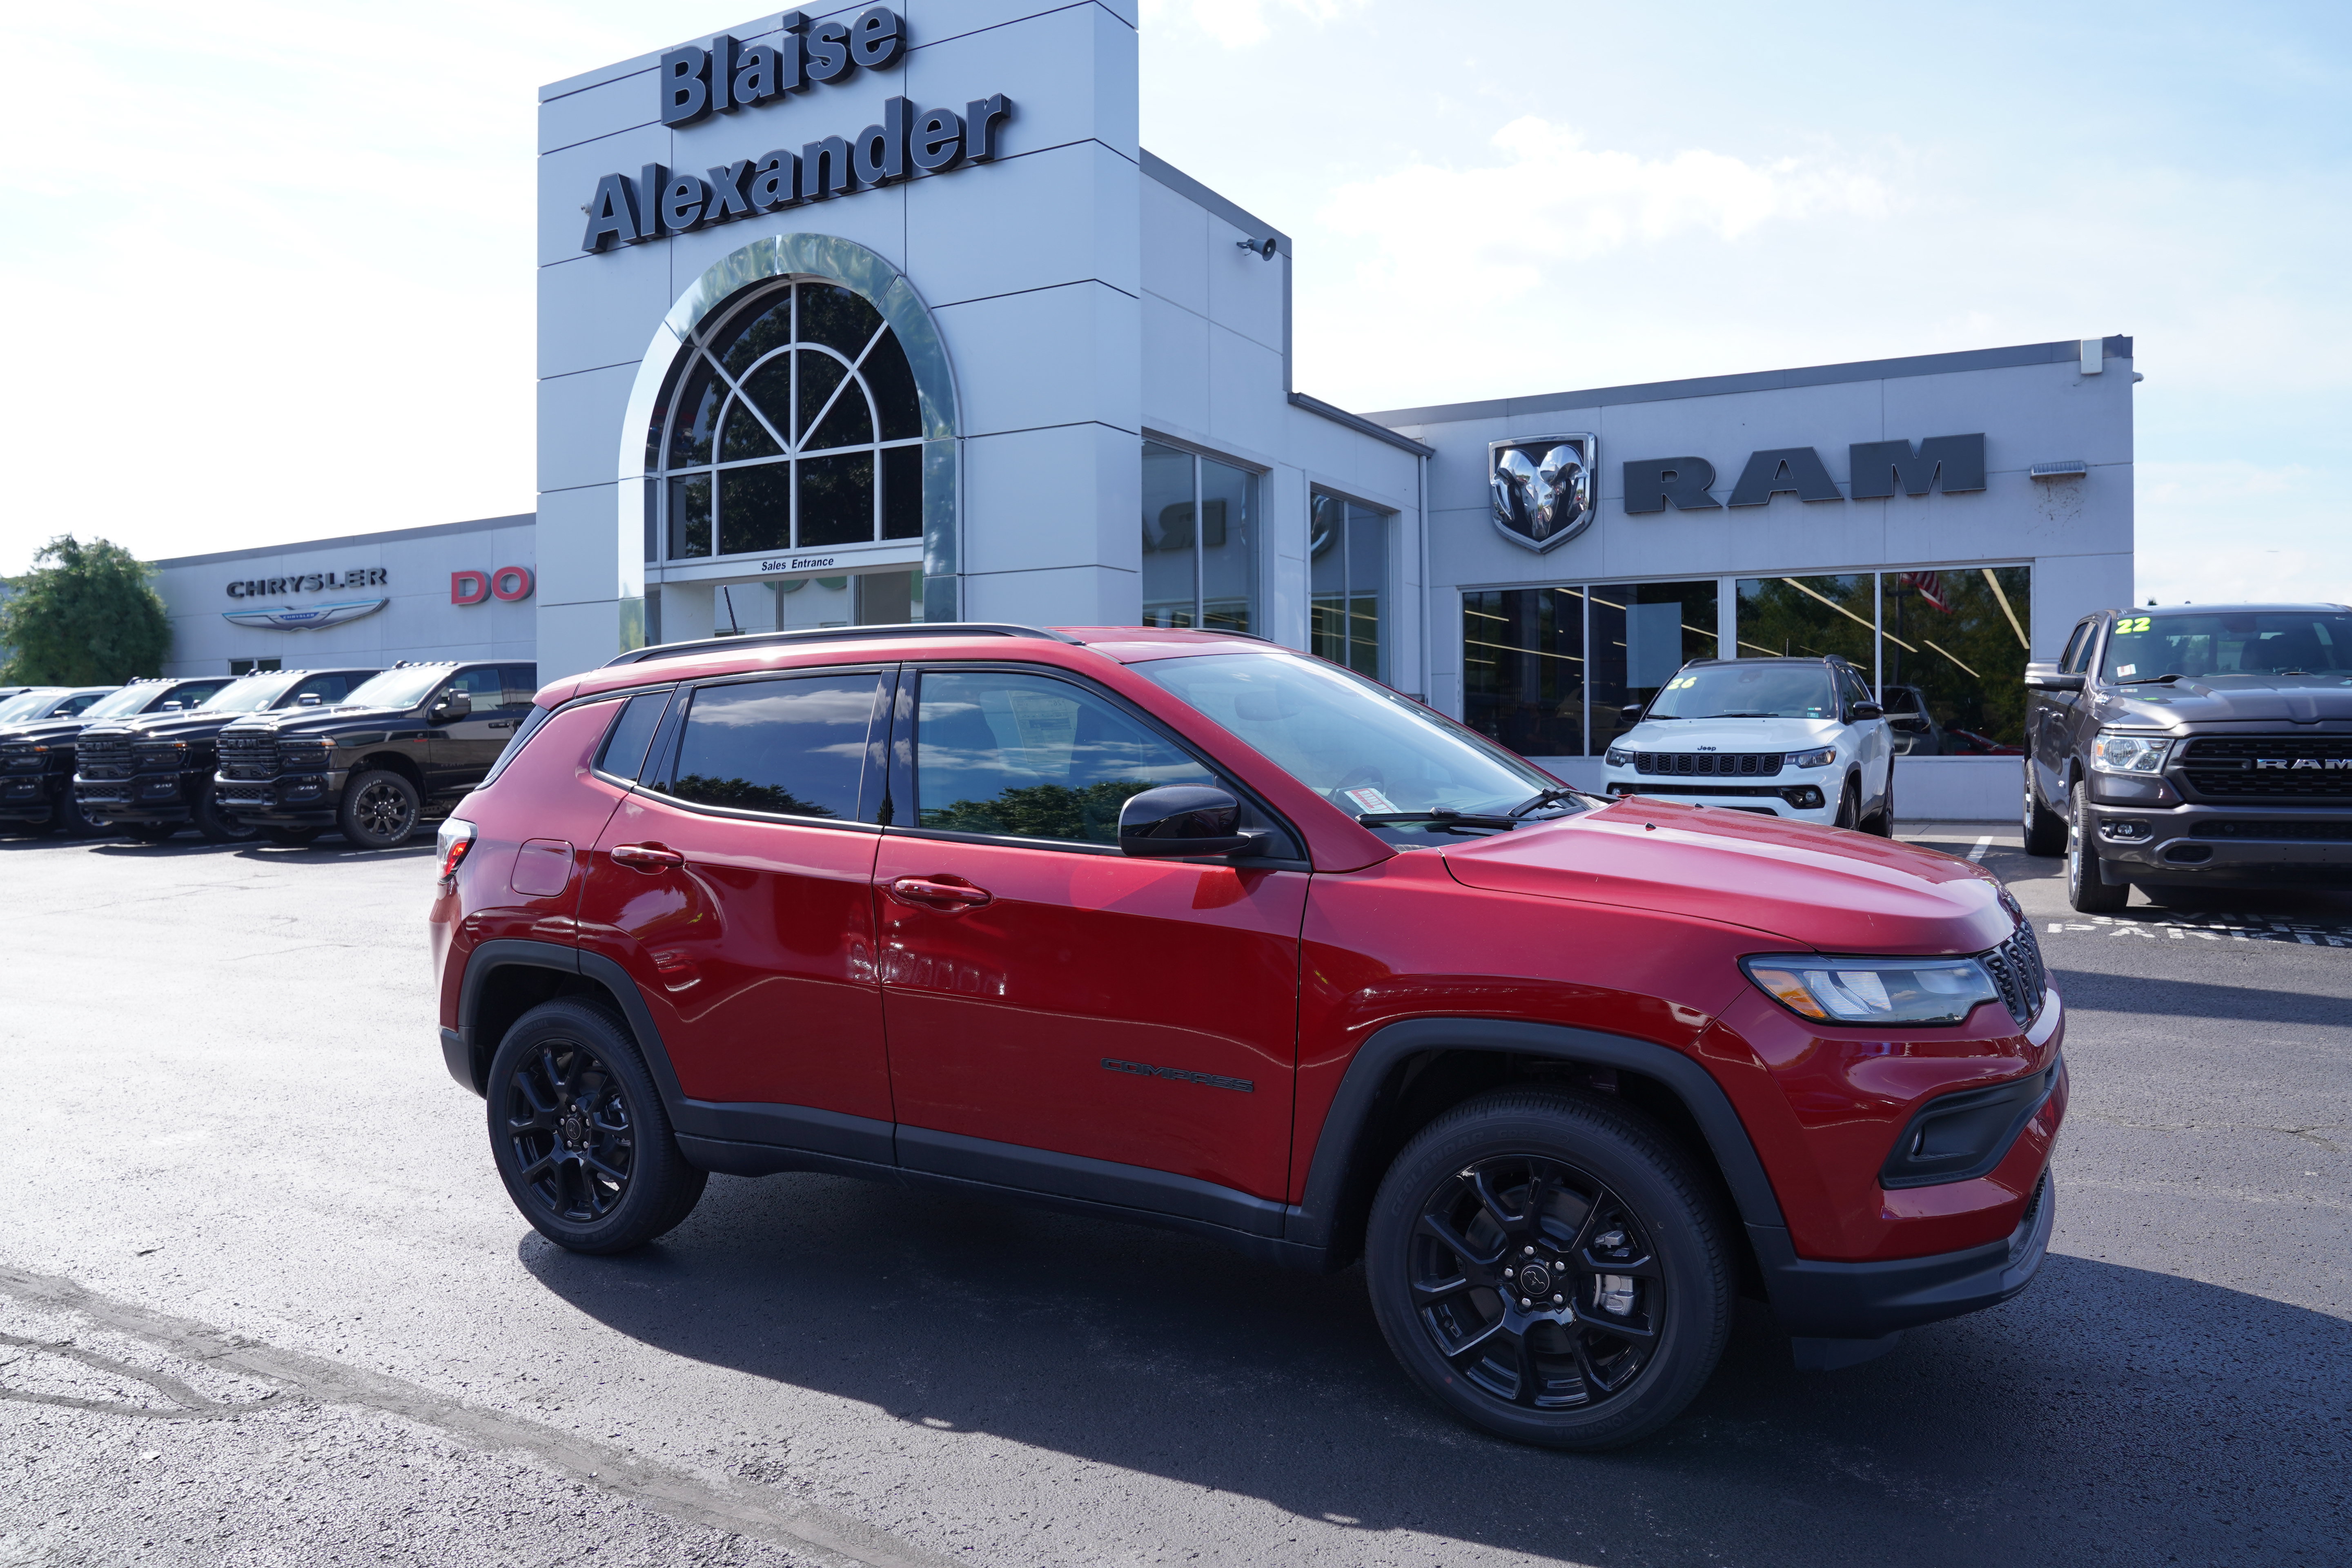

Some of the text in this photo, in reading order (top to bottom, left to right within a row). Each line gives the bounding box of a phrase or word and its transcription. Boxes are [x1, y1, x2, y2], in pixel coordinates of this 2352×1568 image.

[660, 6, 906, 128] Blaise
[581, 93, 1011, 253] Alexander
[1623, 433, 1986, 514] RAM
[762, 558, 834, 571] Sales Entrance
[226, 568, 388, 598] CHRYSLER
[451, 564, 537, 605] DO
[2115, 617, 2151, 635] 22
[1667, 677, 1698, 690] 26
[85, 741, 116, 751] RAM
[227, 738, 258, 748] RAM
[2256, 759, 2352, 769] RAM
[1100, 1058, 1254, 1093] COMPASS
[1390, 1131, 1486, 1218] GEOLANDAR
[1554, 1412, 1633, 1440] YOKOHAMA
